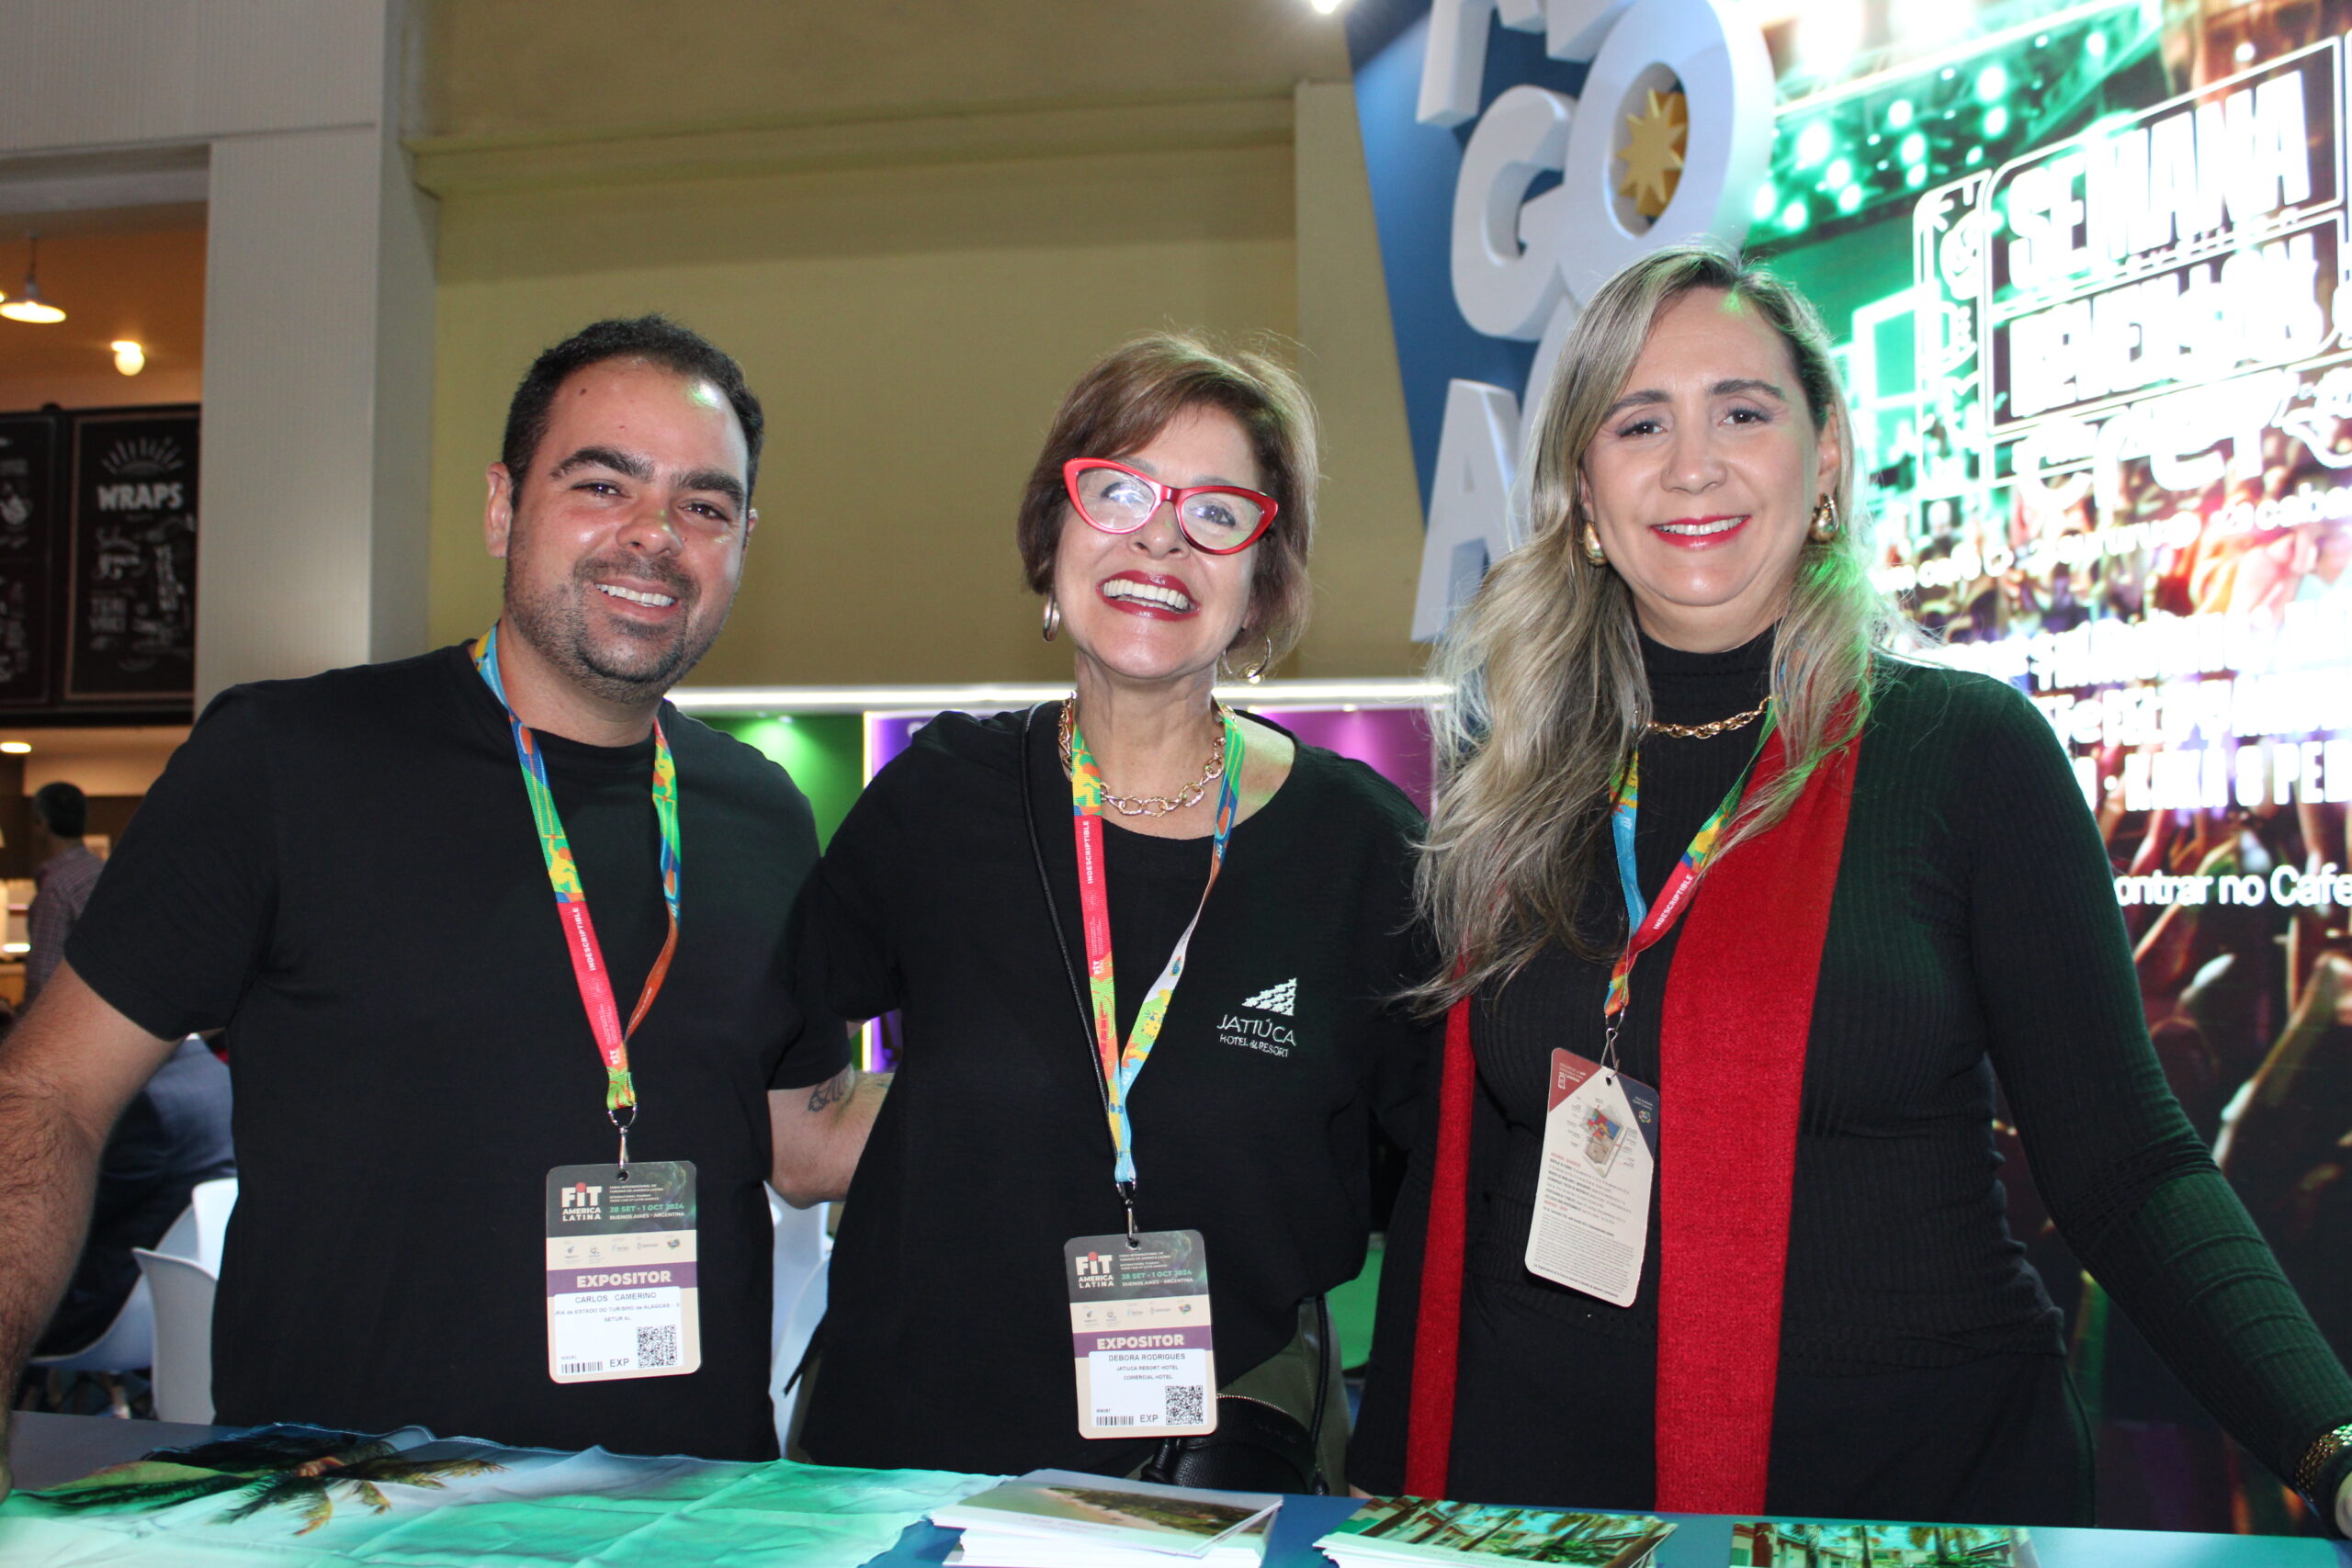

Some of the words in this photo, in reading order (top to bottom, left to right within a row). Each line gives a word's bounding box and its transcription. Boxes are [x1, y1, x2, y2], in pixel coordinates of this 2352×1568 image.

[96, 482, 184, 511] WRAPS
[1083, 820, 1093, 884] INDESCRIPTIBLE
[2115, 870, 2213, 905] ontrar
[2219, 875, 2266, 905] no
[1652, 874, 1693, 930] INDESCRIPTIBLE
[572, 908, 596, 971] INDESCRIPTIBLE
[1216, 1014, 1296, 1046] JATIÚCA
[1219, 1033, 1249, 1046] HOTEL
[1259, 1042, 1289, 1057] RESORT
[562, 1207, 601, 1215] AMERICA
[576, 1270, 672, 1288] EXPOSITOR
[575, 1294, 608, 1303] CARLOS
[615, 1292, 657, 1301] CAMERINO
[1097, 1334, 1184, 1349] EXPOSITOR
[610, 1359, 629, 1367] EXP
[1140, 1415, 1158, 1423] EXP
